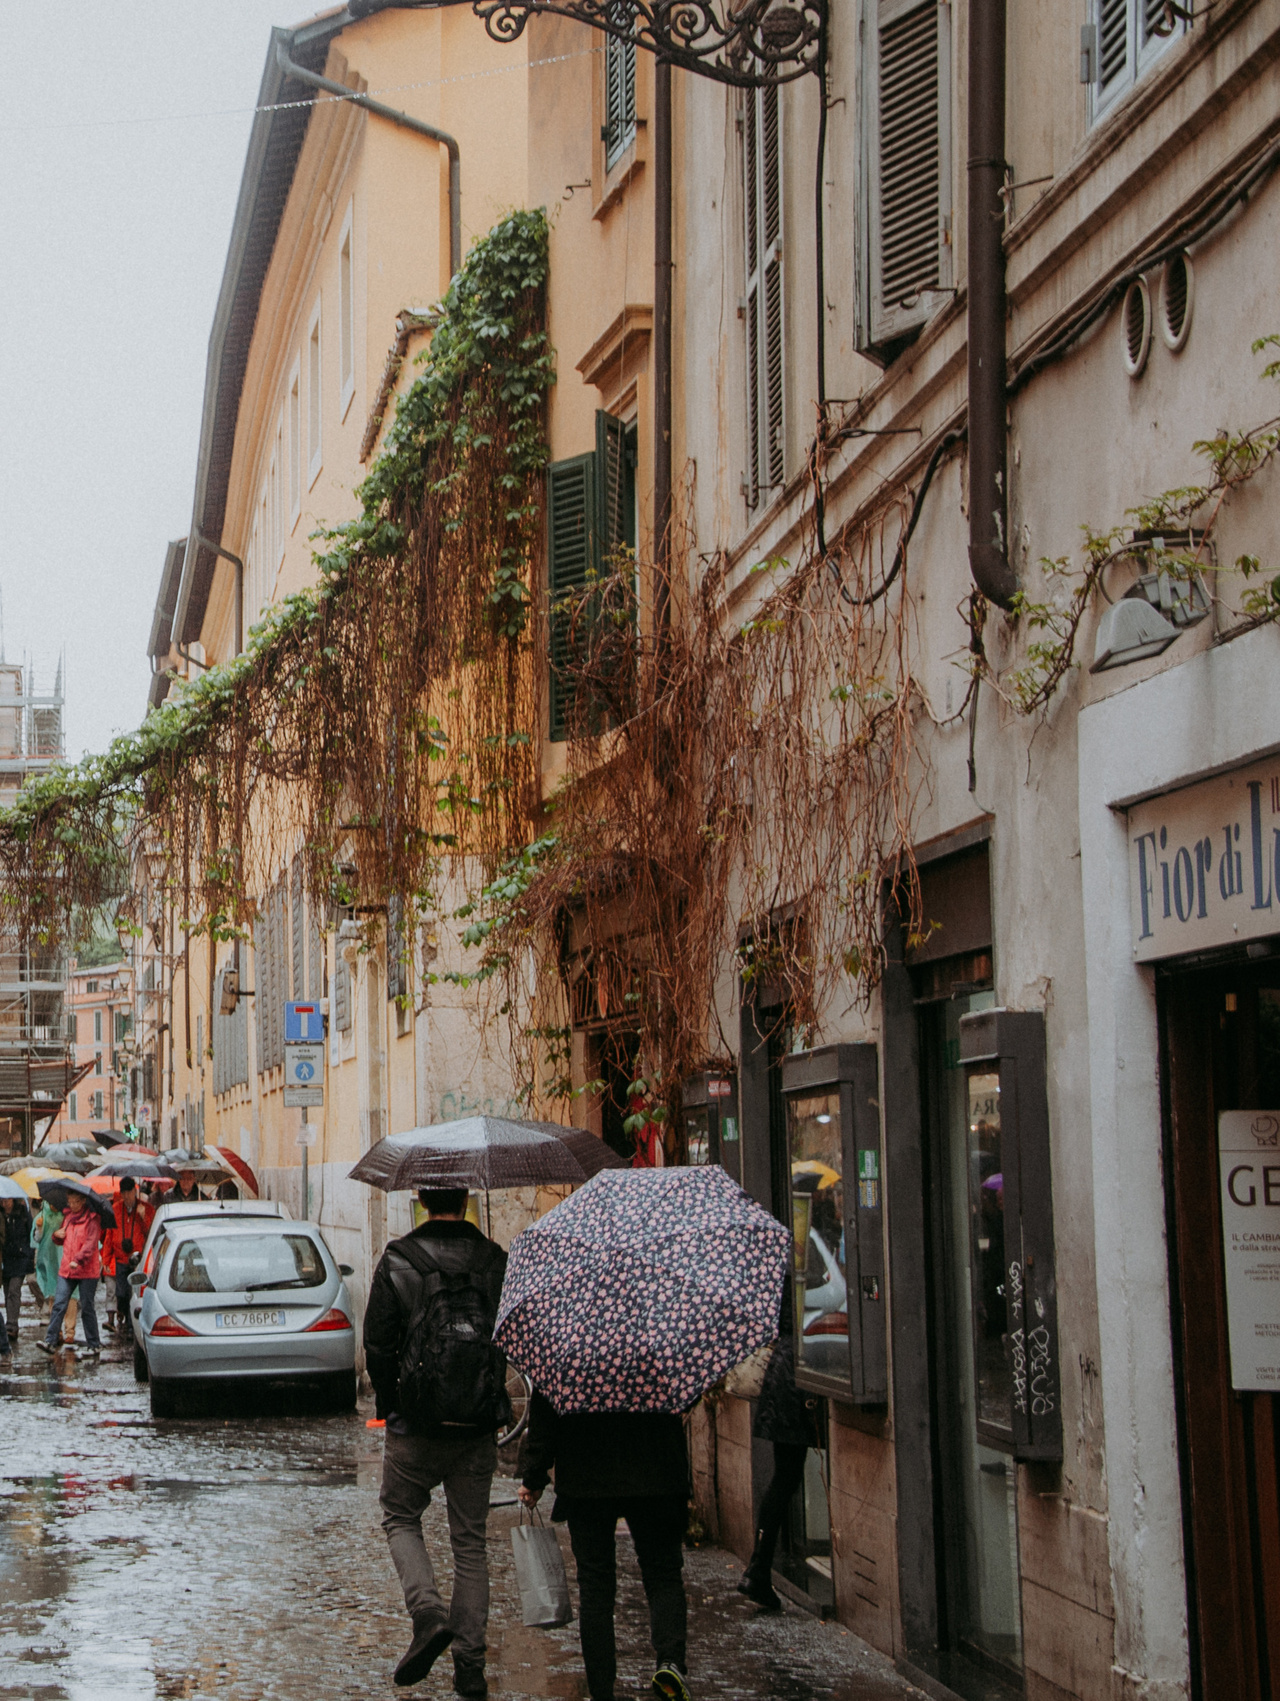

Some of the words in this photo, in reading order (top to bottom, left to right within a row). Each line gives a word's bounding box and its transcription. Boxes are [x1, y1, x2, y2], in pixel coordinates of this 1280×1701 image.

[1134, 825, 1212, 941] Fior
[1219, 822, 1243, 901] di
[223, 1313, 238, 1326] CC
[241, 1311, 278, 1325] 786PC
